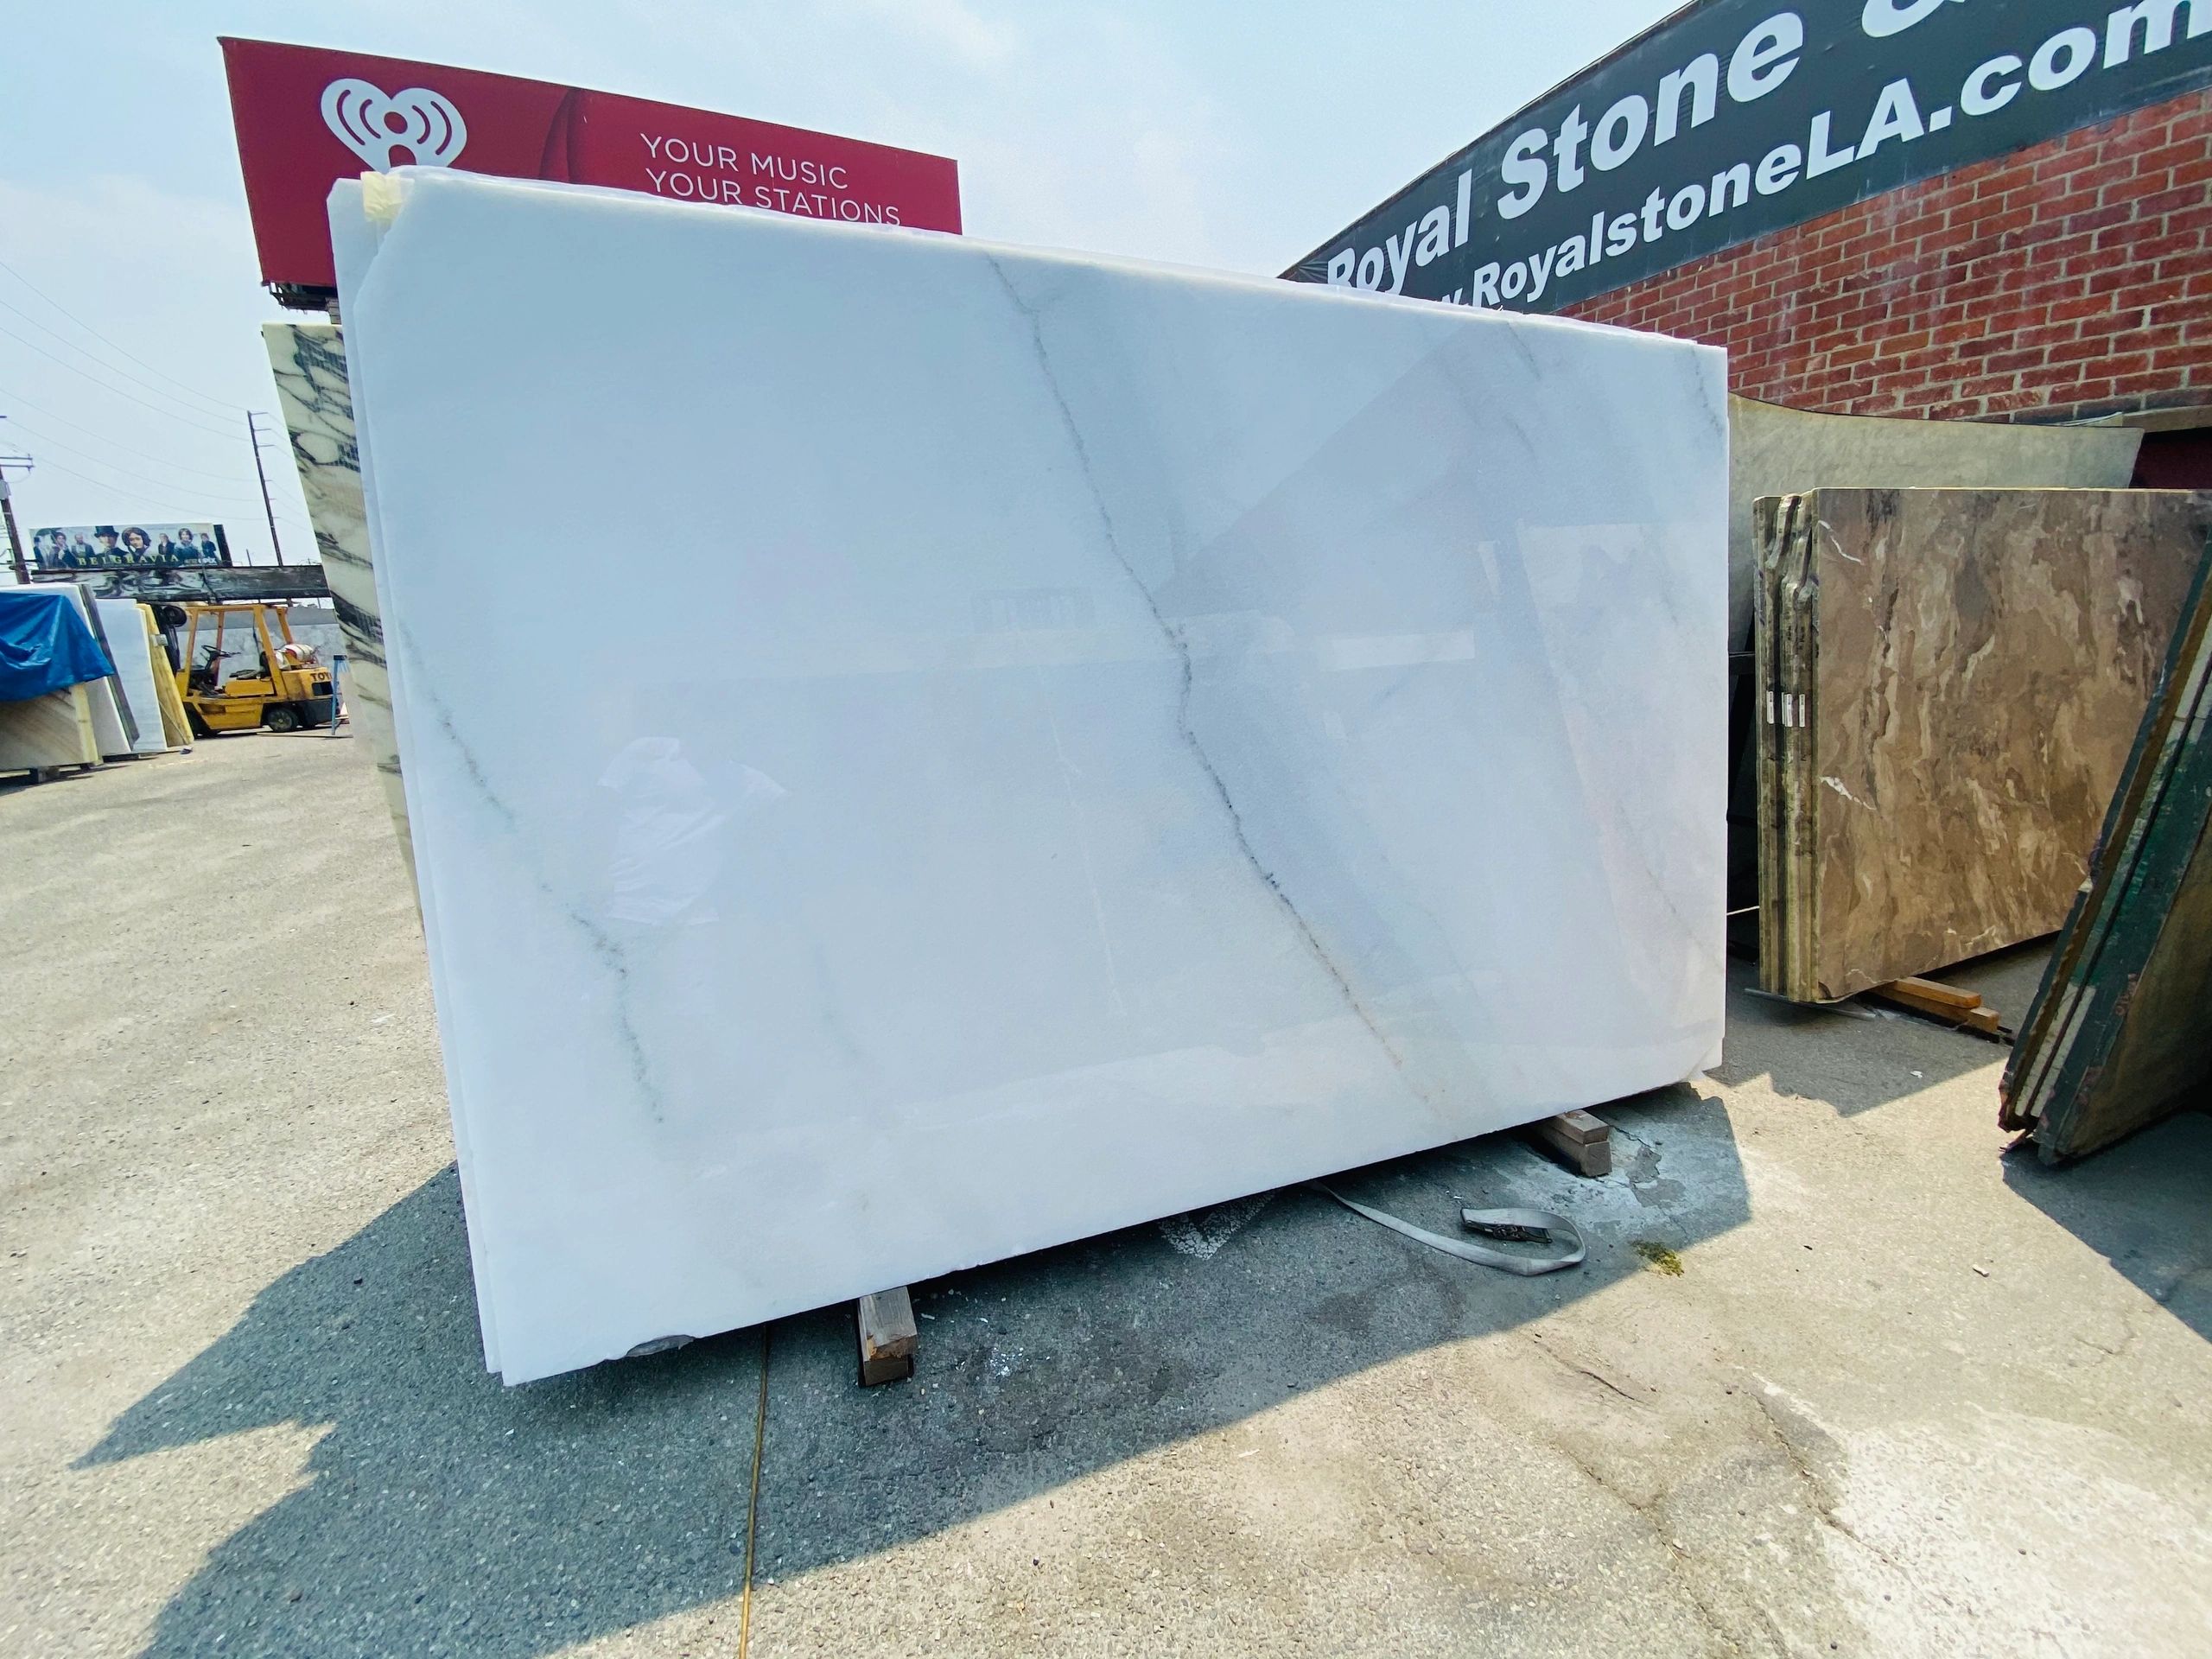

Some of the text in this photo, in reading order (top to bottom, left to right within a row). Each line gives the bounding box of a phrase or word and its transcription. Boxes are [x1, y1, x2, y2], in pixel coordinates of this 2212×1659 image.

[639, 133, 849, 189] YOUR MUSIC
[1327, 11, 1803, 295] Royal Stone
[645, 168, 900, 226] YOUR STATIONS
[77, 555, 179, 566] BELGRAVIA
